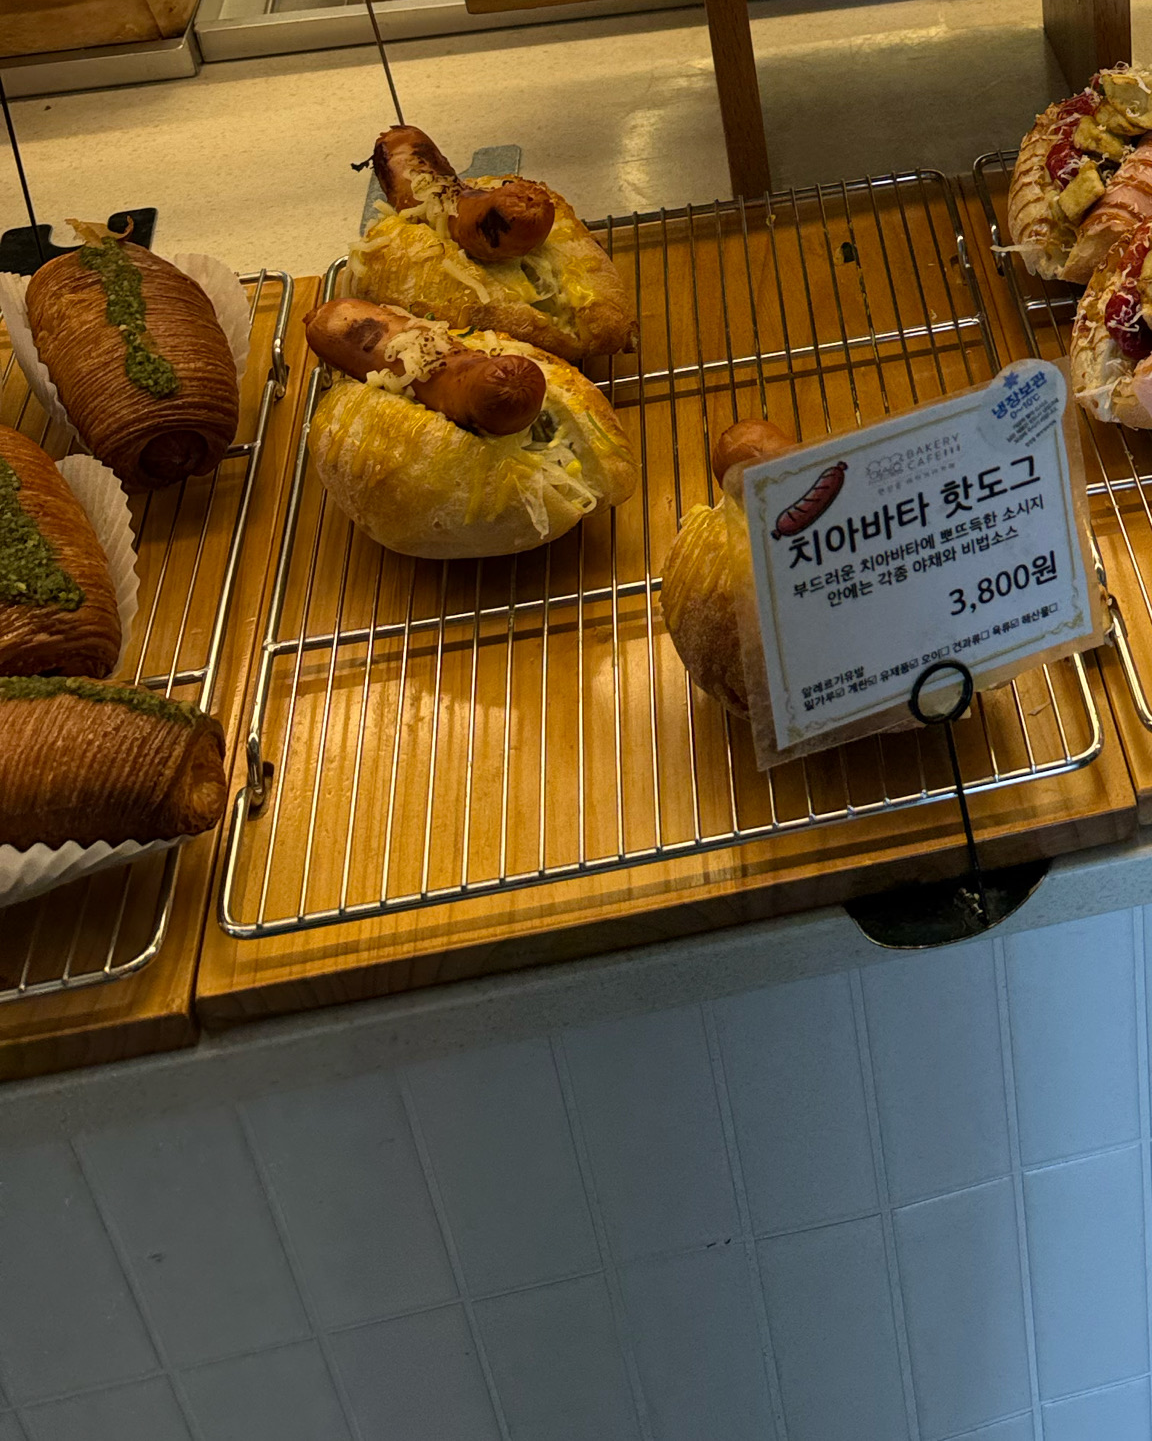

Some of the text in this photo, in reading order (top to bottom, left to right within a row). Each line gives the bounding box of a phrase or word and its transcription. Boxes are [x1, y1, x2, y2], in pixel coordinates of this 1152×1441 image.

[992, 370, 1047, 419] 냉장보관
[906, 432, 960, 459] BAKERY
[788, 454, 1042, 570] 치아바타 핫도그
[793, 564, 856, 600] 부드러운
[860, 536, 936, 573] 치아바타에
[1001, 493, 1045, 522] 소시지
[827, 526, 1019, 609] 안에는 각종 야채와 비법소스
[948, 550, 1058, 617] 3,800원
